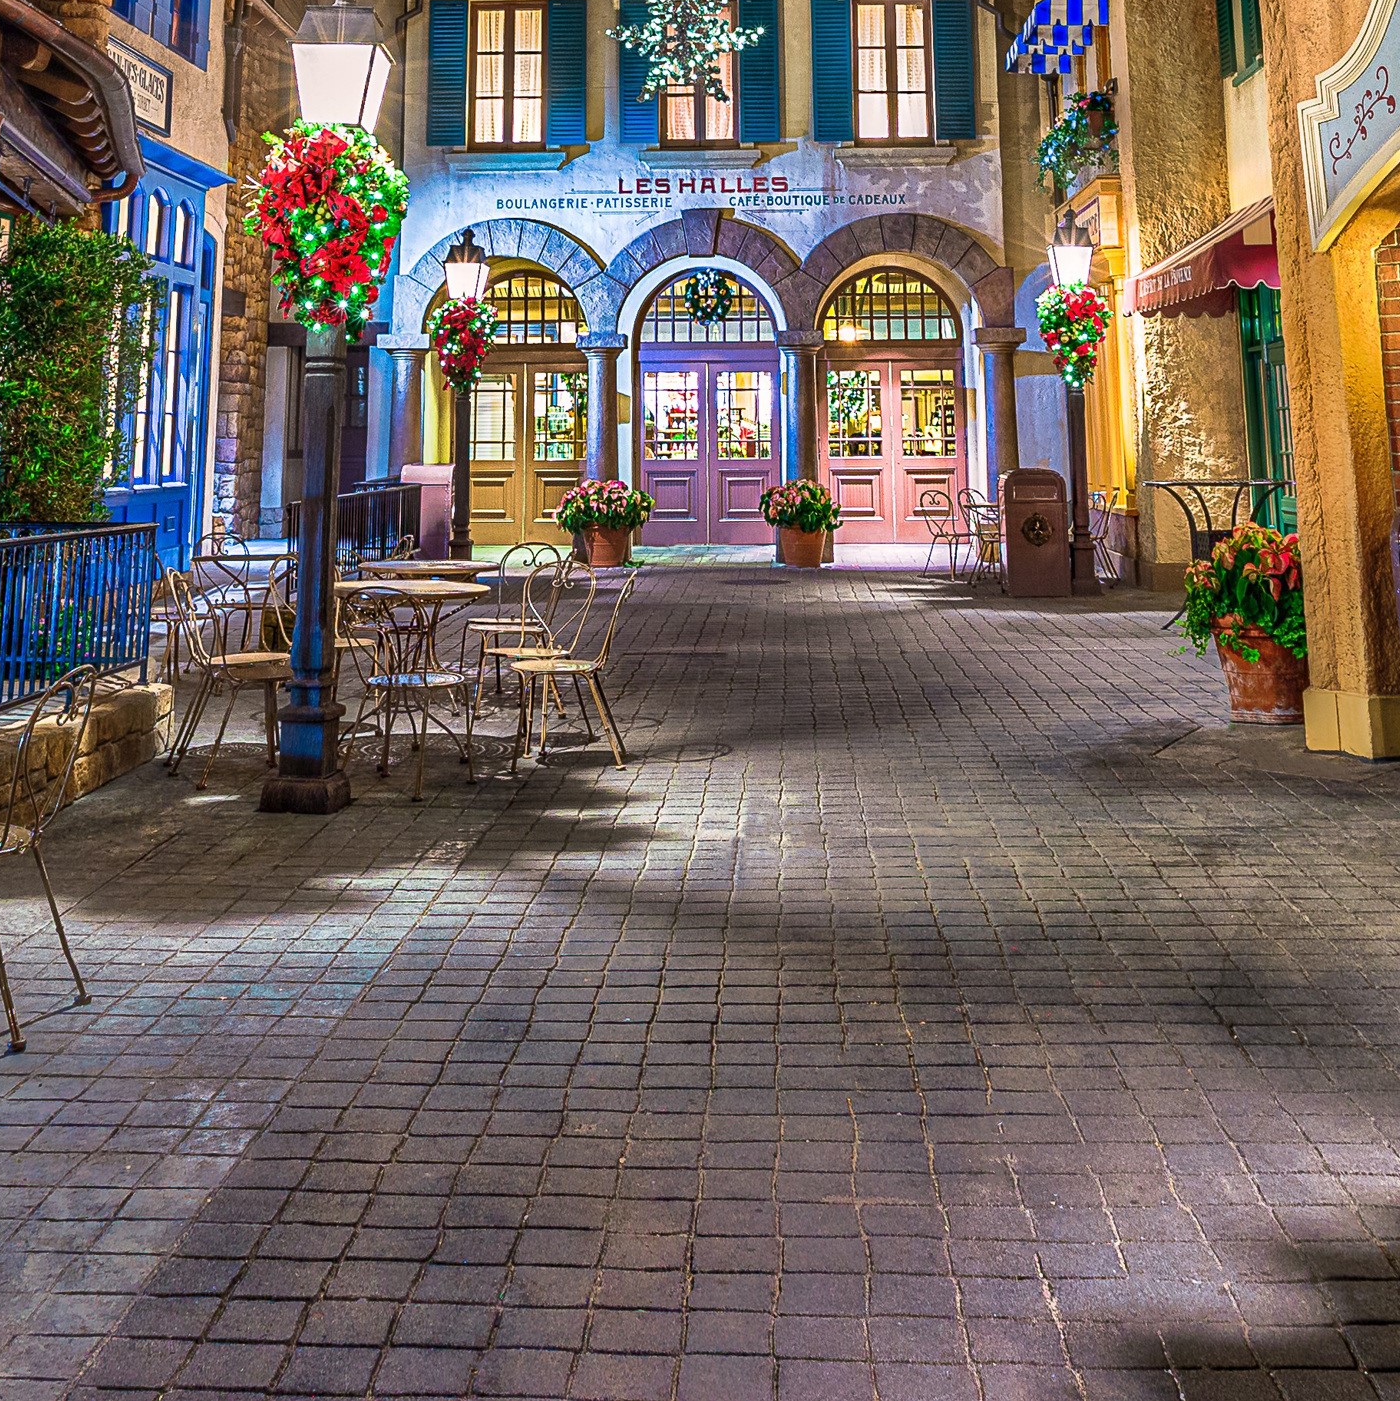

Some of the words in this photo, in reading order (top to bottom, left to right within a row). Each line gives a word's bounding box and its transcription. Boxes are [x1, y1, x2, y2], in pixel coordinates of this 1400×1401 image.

[618, 176, 671, 194] LES
[678, 176, 790, 194] HALLES
[496, 197, 588, 210] BOULANGERIE
[596, 196, 673, 209] PATISSERIE
[728, 193, 760, 207] CAFÉ
[766, 194, 830, 207] BOUTIQUE
[847, 193, 906, 206] CADEAUX
